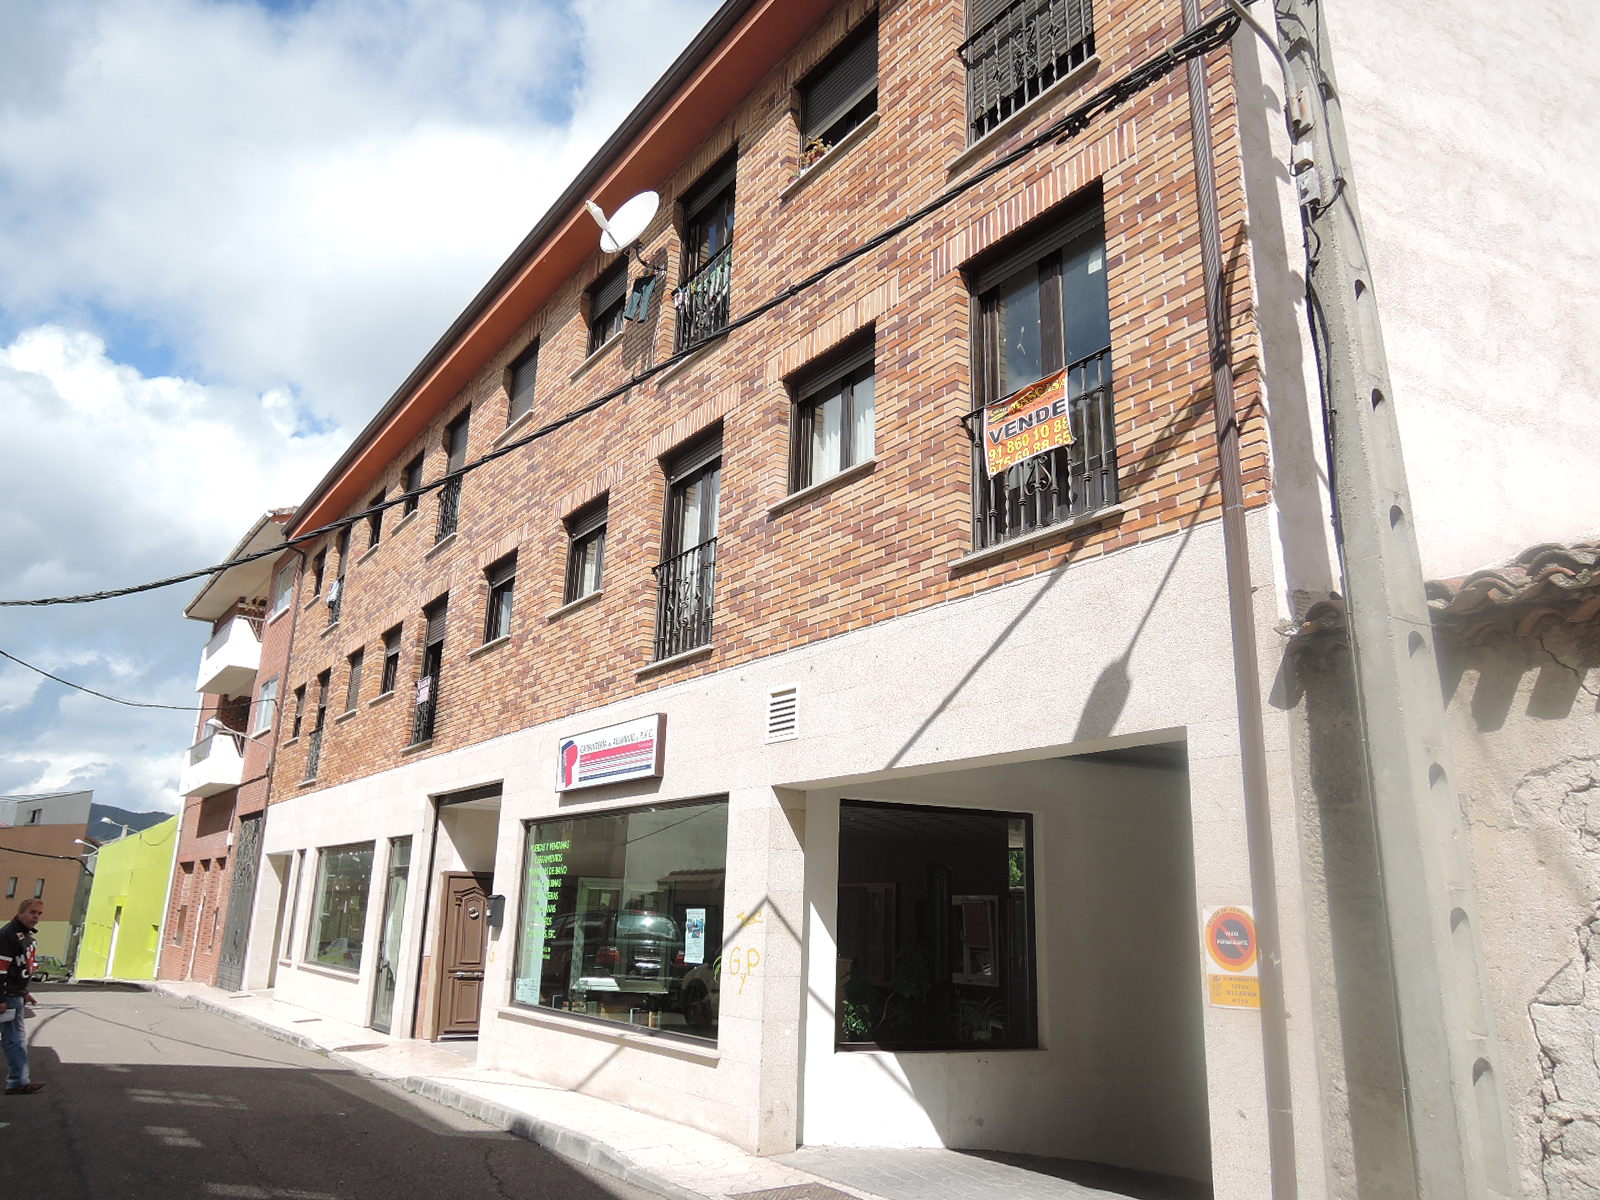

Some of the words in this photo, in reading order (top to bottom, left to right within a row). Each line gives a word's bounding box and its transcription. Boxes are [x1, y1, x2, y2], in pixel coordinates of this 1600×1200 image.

[988, 397, 1066, 444] VENDE
[989, 445, 1003, 461] 91
[1007, 433, 1030, 454] 860
[1033, 424, 1050, 441] 10
